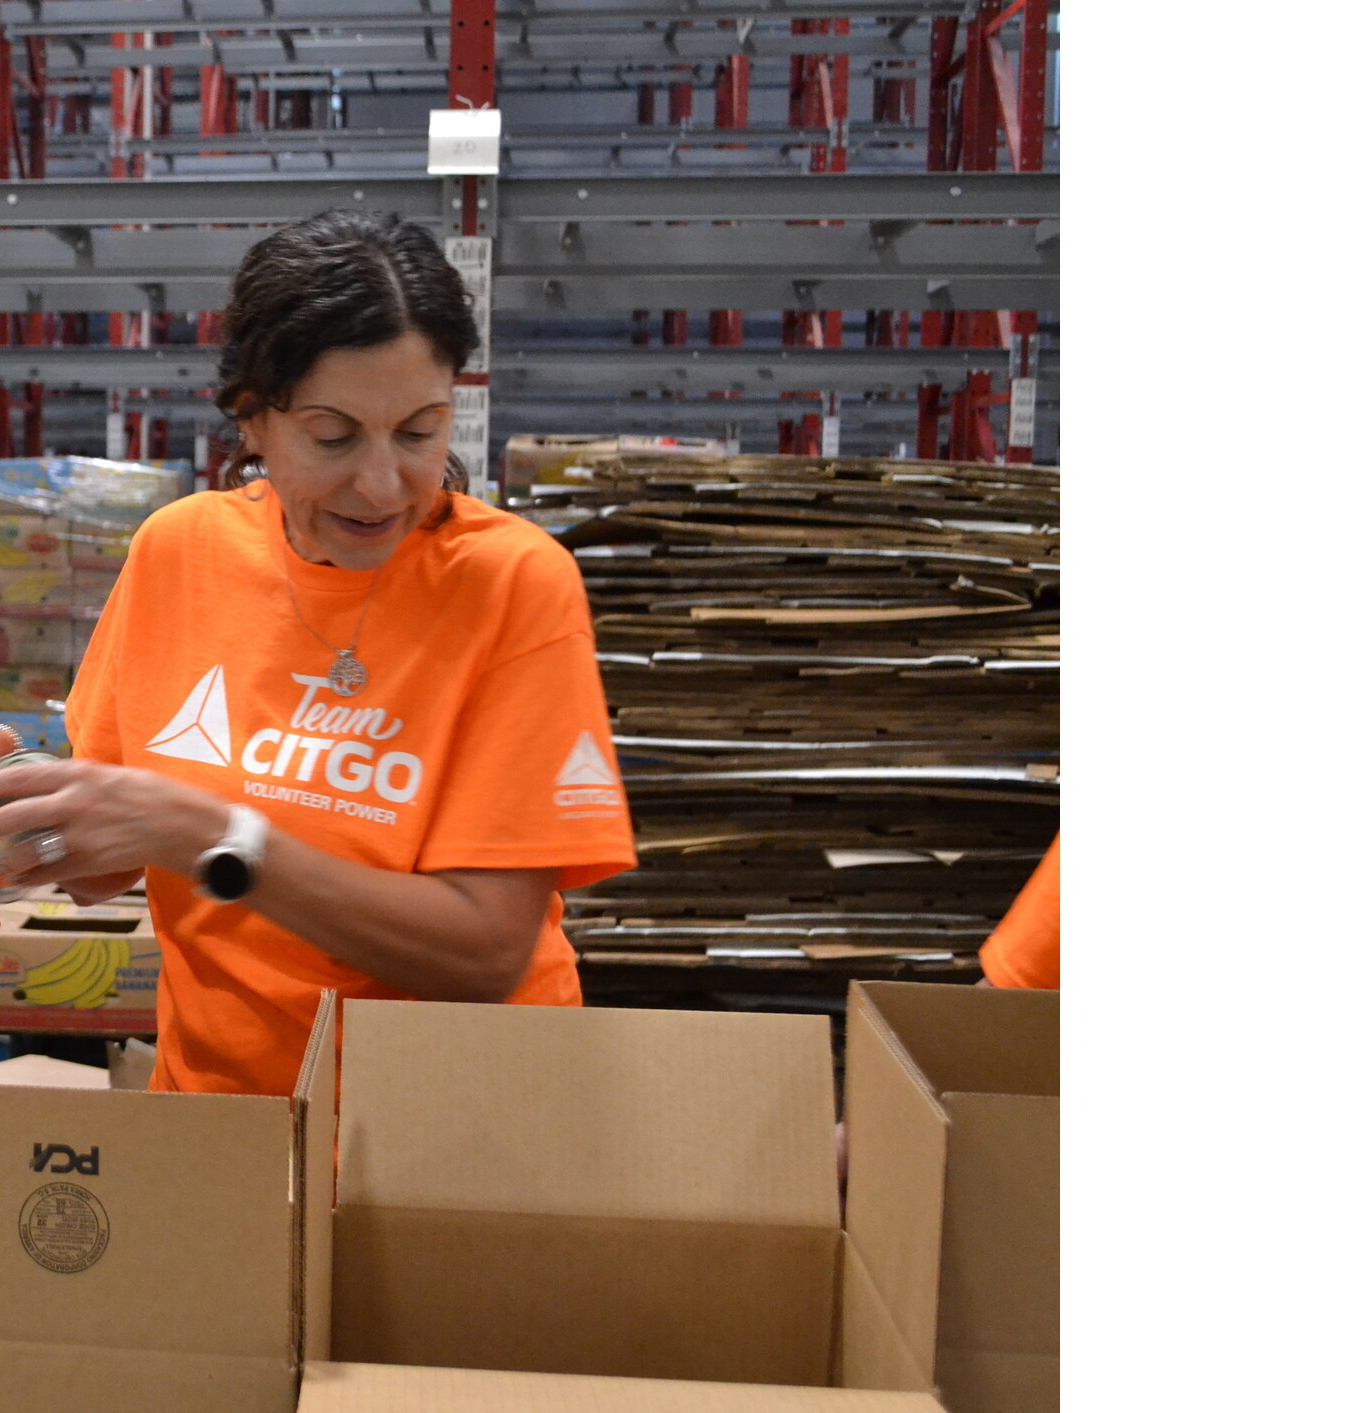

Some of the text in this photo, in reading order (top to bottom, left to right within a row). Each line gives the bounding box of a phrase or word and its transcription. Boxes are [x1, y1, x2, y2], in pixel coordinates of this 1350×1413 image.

[291, 671, 404, 741] Team
[241, 727, 423, 804] CITGO
[244, 780, 398, 826] VOLUNTEER POWER
[30, 1143, 100, 1176] PCA
[37, 1218, 47, 1226] 32
